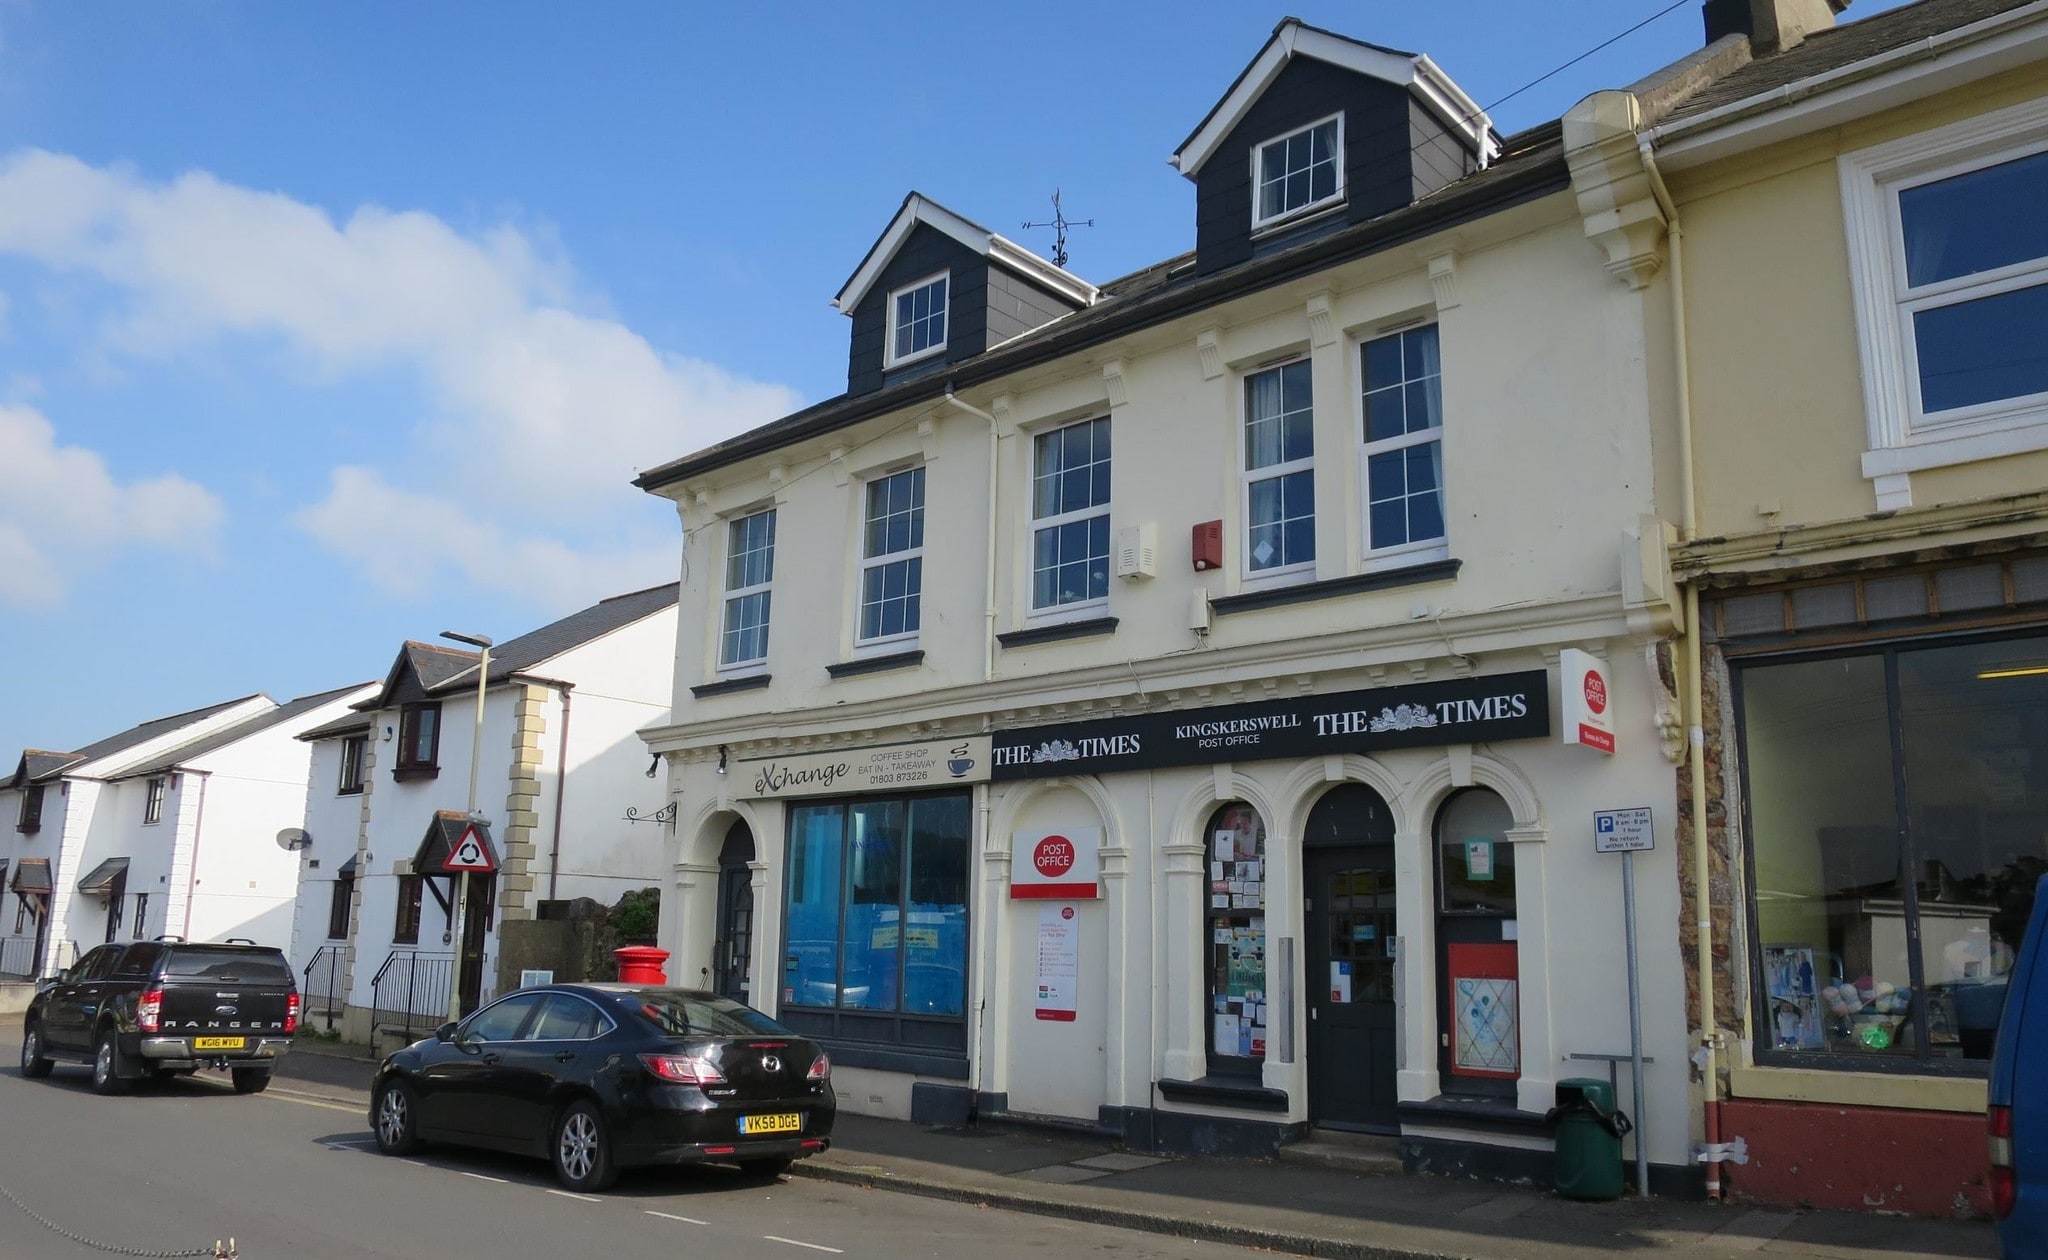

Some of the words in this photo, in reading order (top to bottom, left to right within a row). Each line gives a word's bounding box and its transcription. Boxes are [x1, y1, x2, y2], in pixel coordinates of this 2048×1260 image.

[1588, 678, 1602, 691] POST
[1585, 689, 1605, 705] OFFICE
[1313, 710, 1368, 736] THE
[1436, 693, 1527, 725] TIMES
[1175, 713, 1301, 739] KINGSKERSWELL
[1199, 737, 1223, 749] POST
[1225, 733, 1260, 746] OFFICE
[870, 751, 903, 763] COFFEE
[904, 748, 929, 759] SHOP
[992, 745, 1031, 766] THE
[1078, 733, 1141, 758] TIMES
[857, 765, 872, 775] EAT
[874, 765, 883, 773] IN
[891, 759, 937, 771] TAKEAWAY
[870, 774, 894, 784] 01803
[896, 771, 928, 782] 873226
[1601, 818, 1611, 831] P
[1043, 843, 1067, 855] POST
[1037, 855, 1070, 867] OFFICE
[164, 1020, 282, 1028] RANGER
[201, 1038, 220, 1047] WG16
[222, 1038, 240, 1047] MVU
[747, 1116, 776, 1130] VK58
[778, 1115, 798, 1129] DGE
